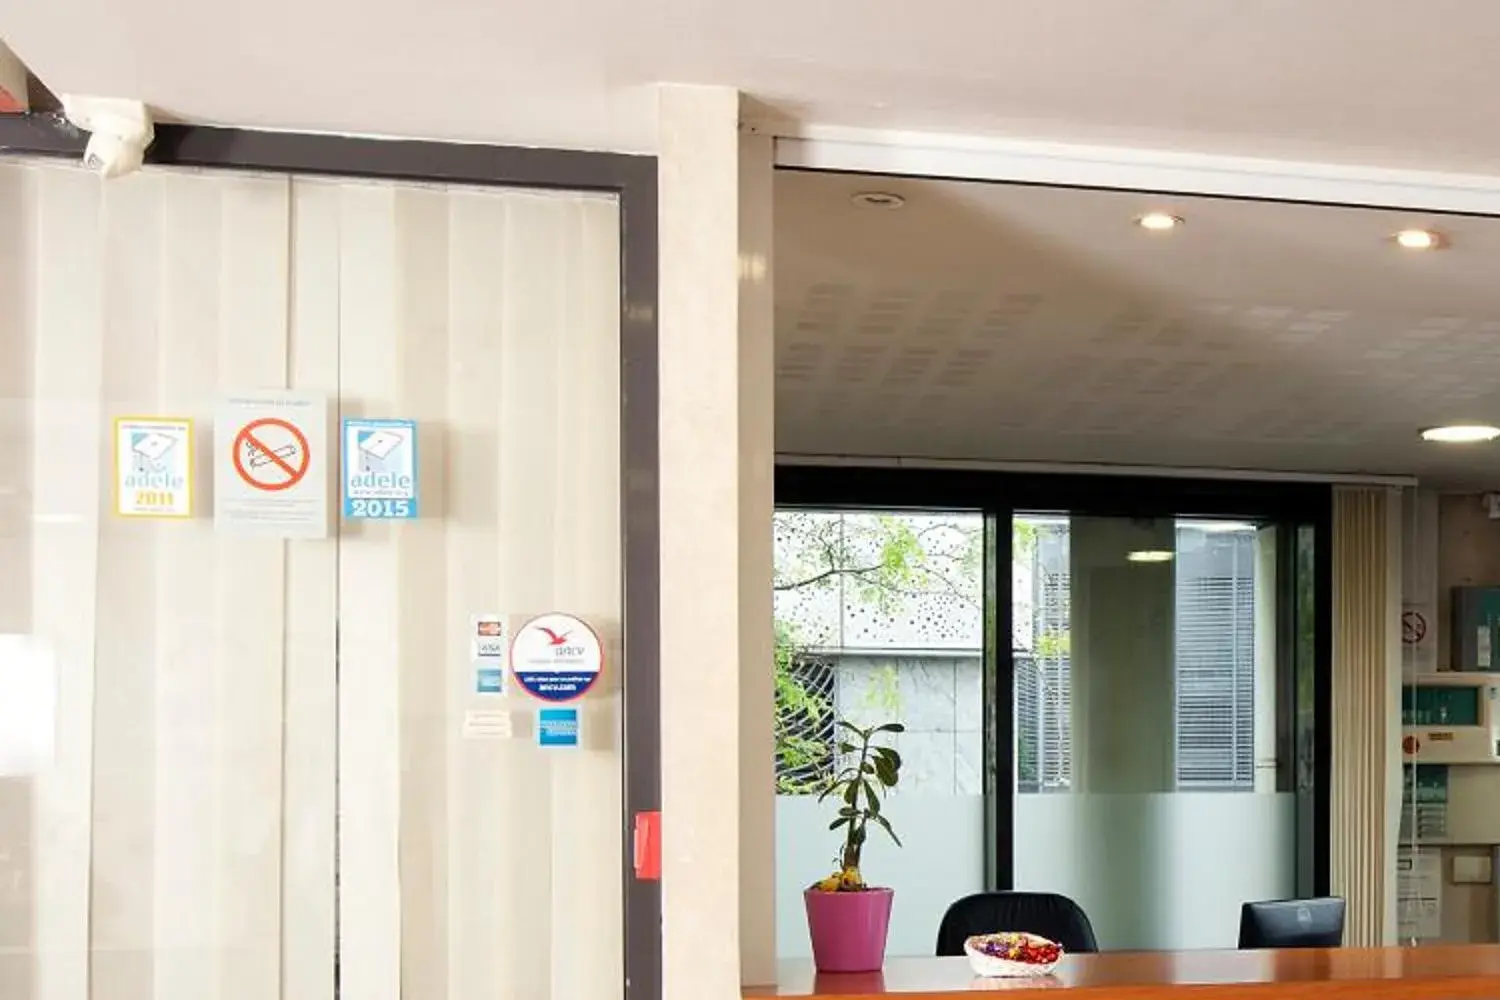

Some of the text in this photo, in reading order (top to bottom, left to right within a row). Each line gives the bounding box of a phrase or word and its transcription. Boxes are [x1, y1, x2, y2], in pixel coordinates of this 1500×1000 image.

[125, 471, 184, 489] adele
[350, 471, 410, 489] adele
[352, 499, 409, 517] 2015
